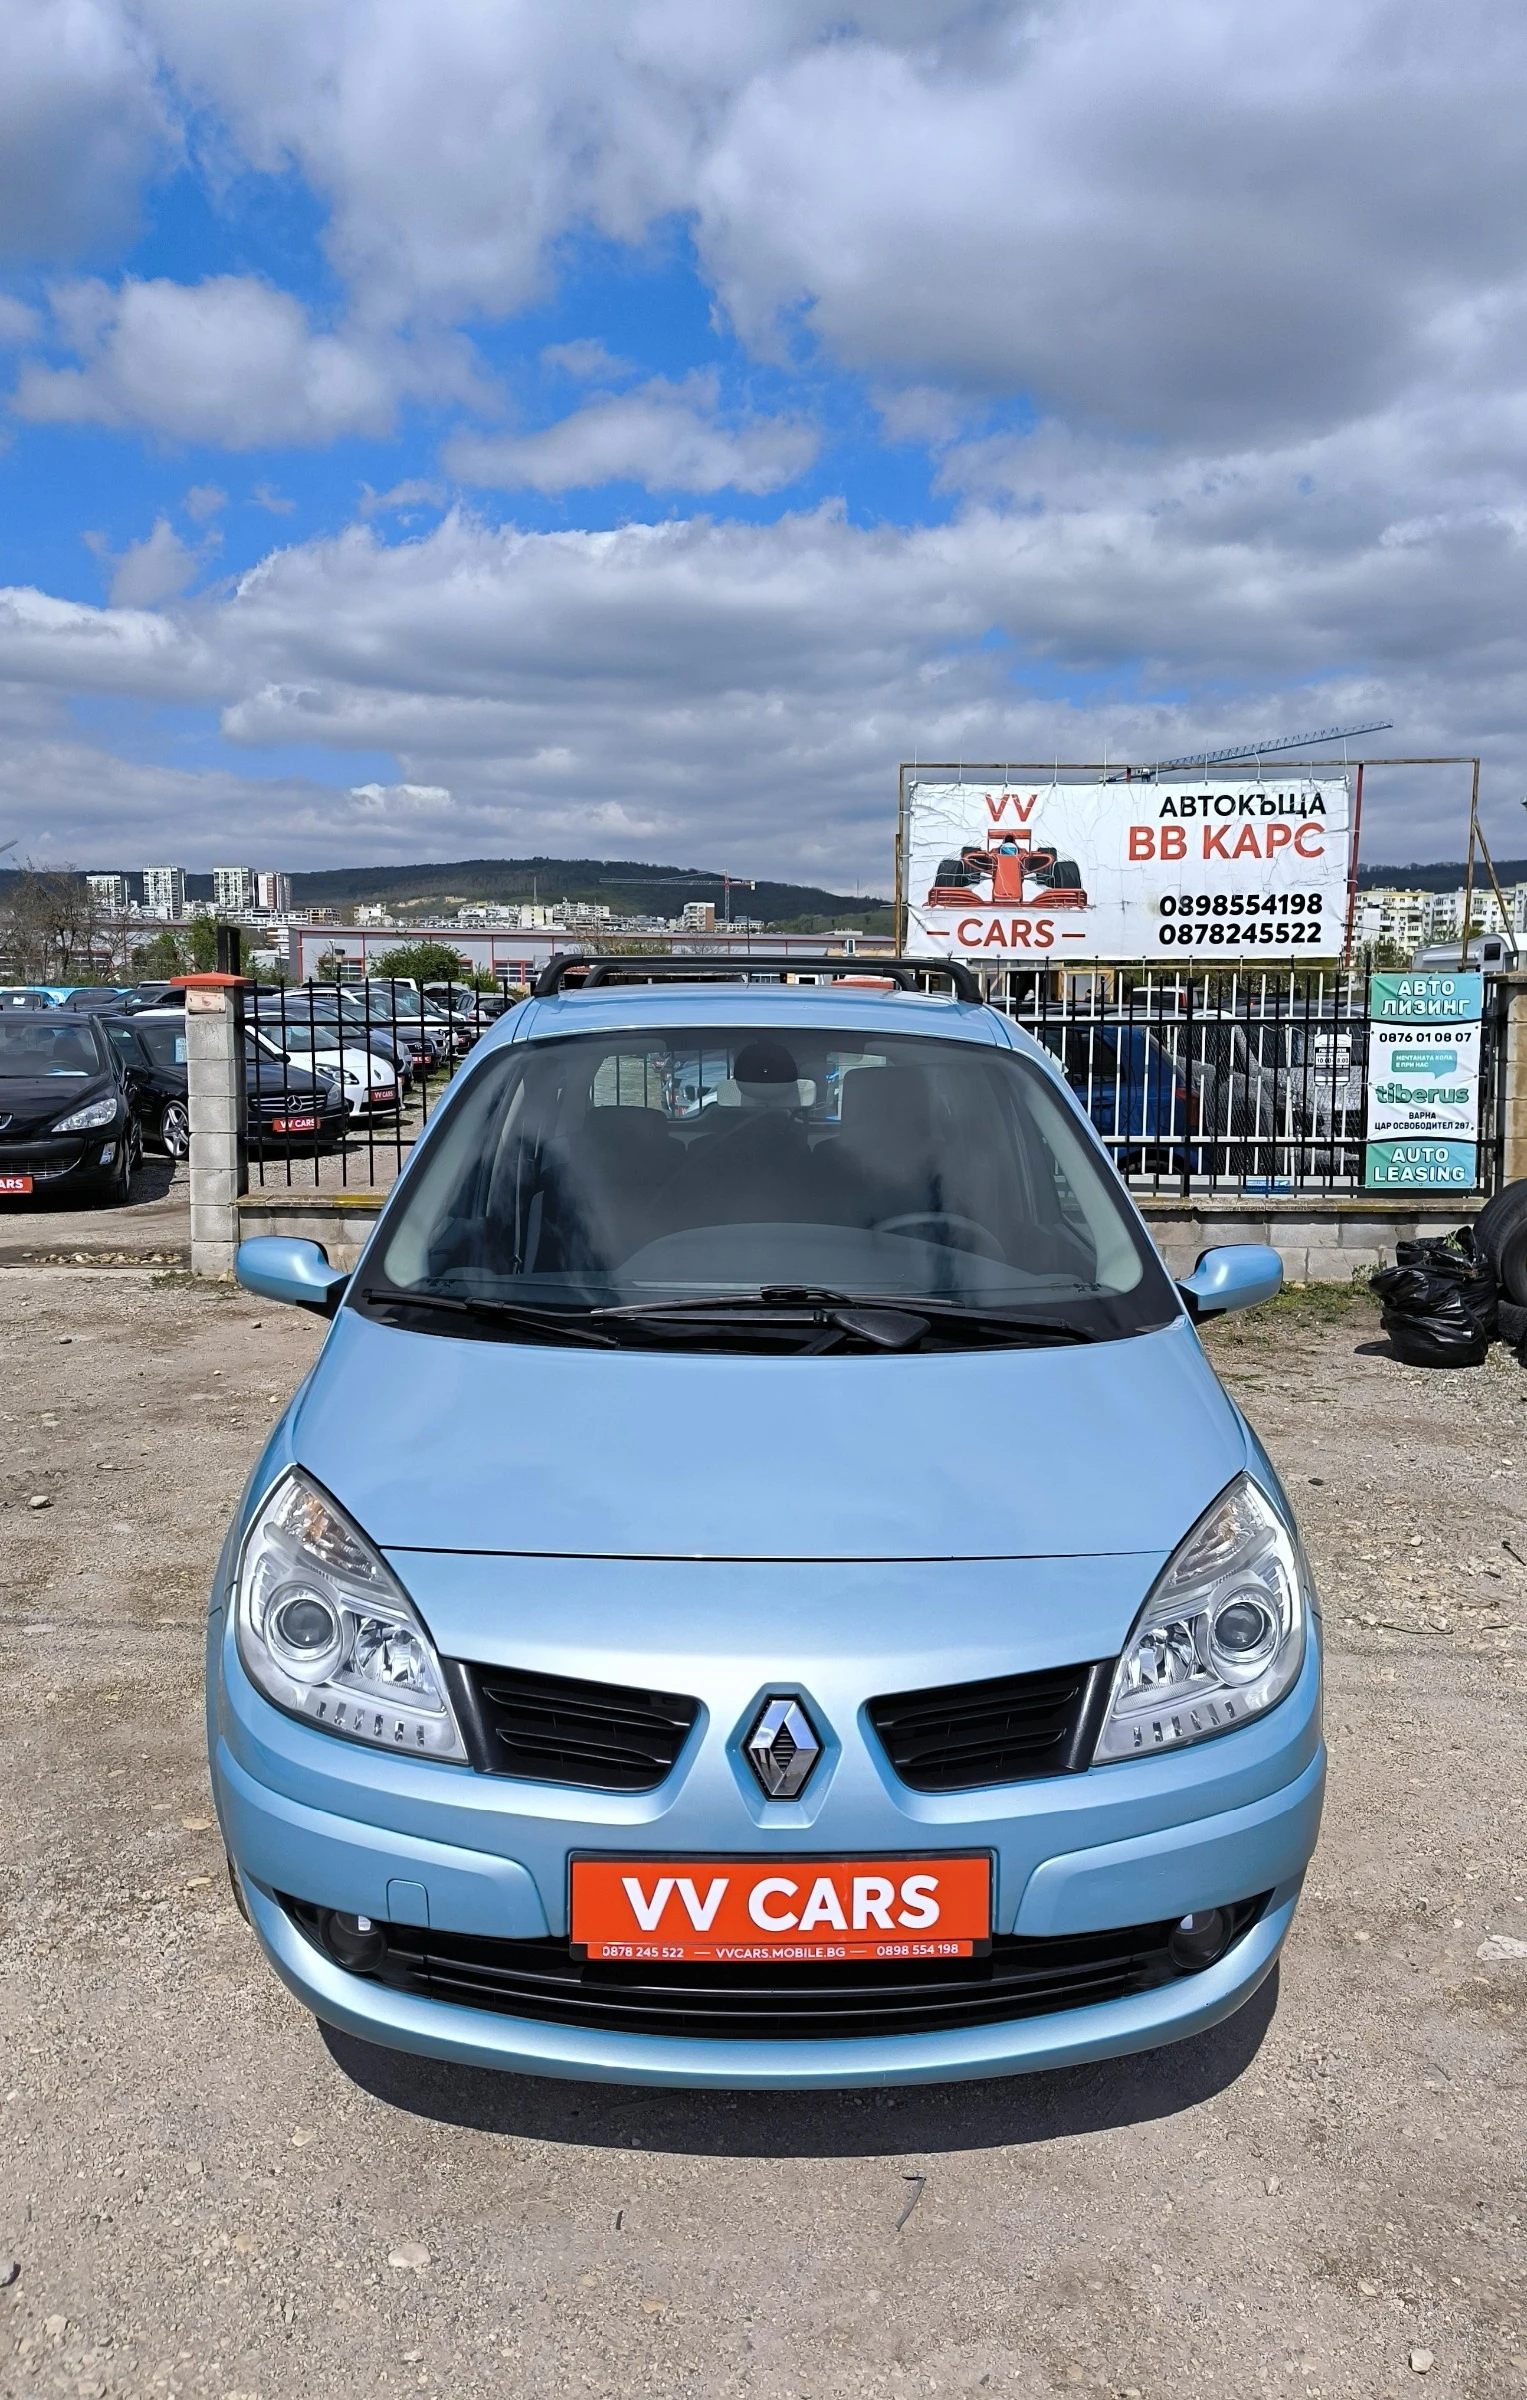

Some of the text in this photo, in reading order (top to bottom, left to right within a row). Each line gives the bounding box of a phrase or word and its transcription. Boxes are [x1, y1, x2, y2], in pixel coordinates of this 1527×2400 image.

[984, 794, 1038, 822] VV
[1159, 792, 1327, 819] АВТОКЪЩА
[1128, 822, 1326, 861] ВВ КАРС
[1159, 893, 1323, 917] 0898554198
[957, 919, 1055, 948] CARS
[1159, 922, 1322, 945] 0878245522
[1397, 980, 1455, 997] АВТО
[1380, 999, 1471, 1016] ЛИЗИНГ
[1379, 1033, 1472, 1043] 0876 01 08 07
[1375, 1083, 1470, 1104] tiberus
[1374, 1121, 1470, 1130] ЦАР ОСВОБОДИТЕЛ 287
[1391, 1147, 1449, 1163] AUTO
[1374, 1166, 1466, 1182] LEASING
[621, 1875, 941, 1931] VV CARS
[602, 1944, 959, 1958] 0878 245 522 VVCARS.MOBILE.BG 0898 554 198
